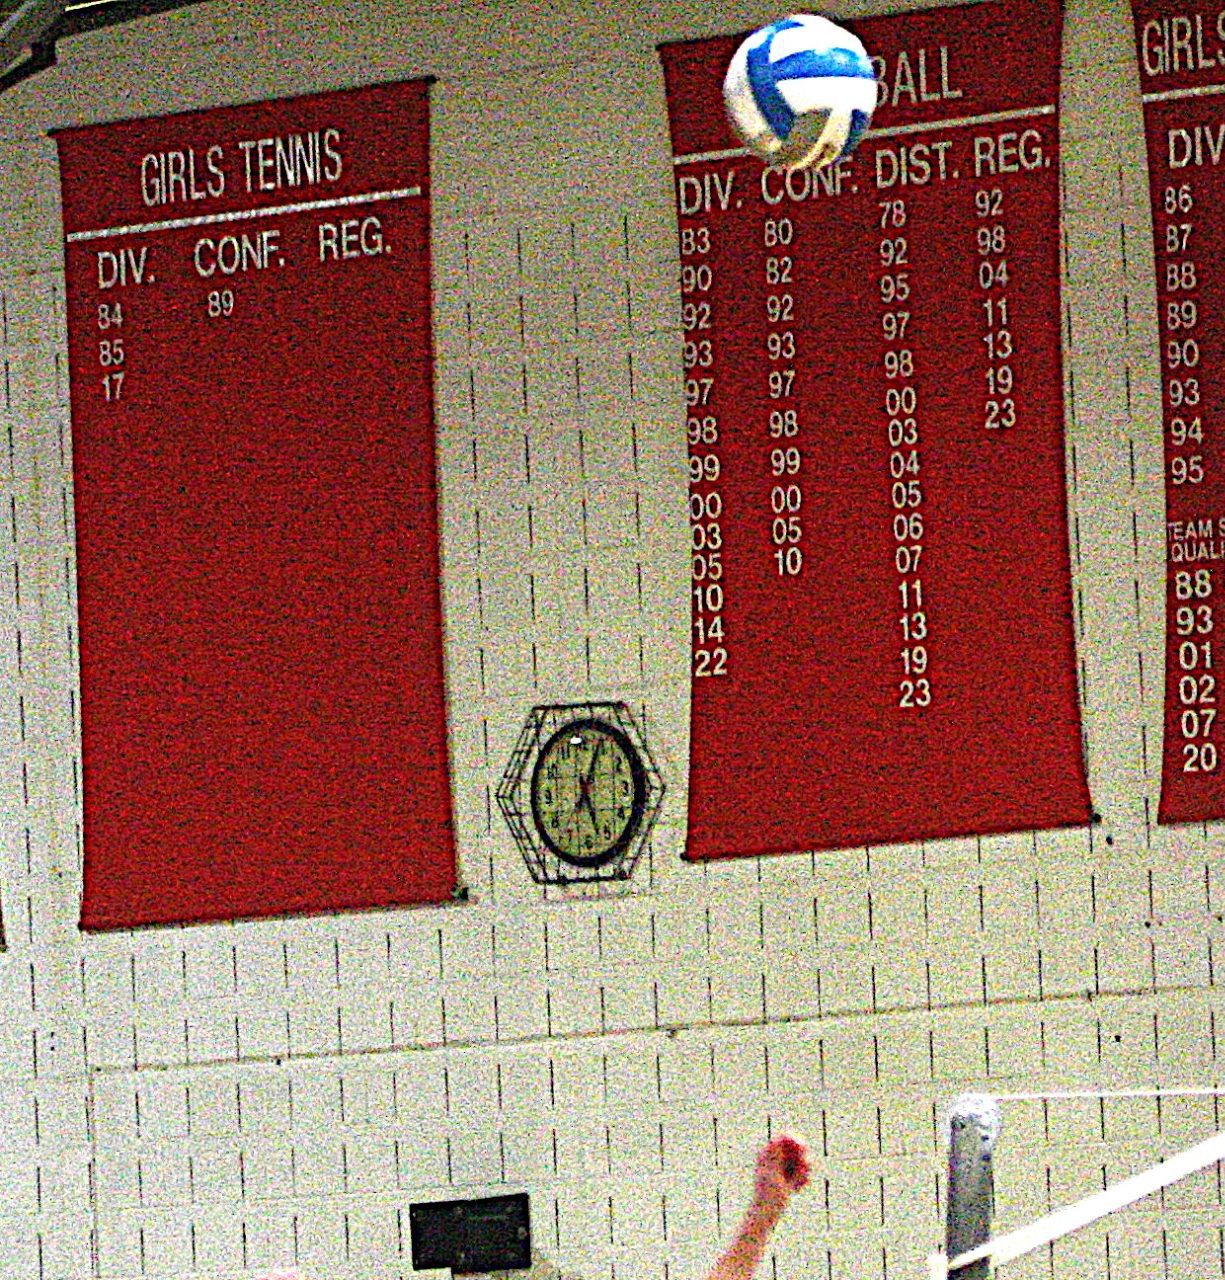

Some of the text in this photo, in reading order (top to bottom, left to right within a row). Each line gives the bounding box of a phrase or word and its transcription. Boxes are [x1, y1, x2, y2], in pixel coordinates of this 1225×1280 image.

[141, 128, 345, 208] GIRLS TENNIS
[678, 171, 743, 215] DIV.
[875, 140, 960, 190] DIST.
[974, 129, 1051, 178] REG.
[879, 200, 906, 229] 78
[975, 189, 1003, 217] 92
[1164, 185, 1193, 215] 86
[681, 228, 711, 255] 83
[763, 219, 793, 247] 80
[977, 225, 1006, 254] 98
[1166, 223, 1193, 252] 87
[97, 216, 392, 290] DIV. CONF. REG.
[879, 237, 908, 266] 92
[682, 265, 712, 293] 90
[765, 256, 793, 285] 82
[978, 260, 1009, 290] 04
[1167, 261, 1197, 291] 88
[880, 274, 910, 303] 95
[97, 303, 123, 331] 84
[207, 290, 235, 318] 89
[683, 302, 712, 331] 92
[766, 294, 794, 322] 92
[983, 297, 1008, 327] 11
[1167, 301, 1197, 330] 89
[882, 311, 909, 340] 97
[99, 339, 125, 367] 85
[684, 340, 714, 368] 93
[767, 332, 796, 360] 93
[983, 331, 1013, 360] 13
[1167, 340, 1199, 368] 90
[884, 350, 914, 379] 98
[101, 372, 126, 401] 17
[686, 378, 714, 407] 97
[768, 370, 796, 399] 97
[985, 365, 1013, 395] 19
[1169, 378, 1200, 407] 93
[886, 387, 917, 417] 00
[985, 399, 1017, 430] 23
[687, 416, 718, 445] 98
[769, 409, 799, 438] 98
[888, 418, 918, 447] 03
[1171, 417, 1203, 446] 94
[689, 454, 720, 482] 99
[771, 447, 800, 476] 99
[890, 450, 920, 478] 04
[1172, 457, 1204, 485] 95
[690, 491, 722, 520] 00
[771, 485, 801, 514] 00
[892, 481, 921, 509] 05
[692, 523, 722, 551] 03
[772, 516, 802, 545] 05
[894, 513, 924, 541] 06
[1167, 519, 1212, 539] TEAM
[692, 553, 723, 582] 05
[773, 546, 802, 576] 10
[895, 545, 923, 574] 07
[693, 583, 724, 613] 10
[898, 579, 923, 610] 11
[1176, 570, 1211, 600] 88
[694, 615, 726, 645] 14
[899, 612, 928, 641] 13
[1176, 607, 1213, 636] 93
[694, 647, 728, 677] 22
[900, 646, 928, 675] 19
[1179, 642, 1213, 670] 01
[899, 678, 932, 708] 23
[1179, 675, 1216, 704] 02
[1181, 710, 1216, 738] 07
[1183, 743, 1218, 772] 20
